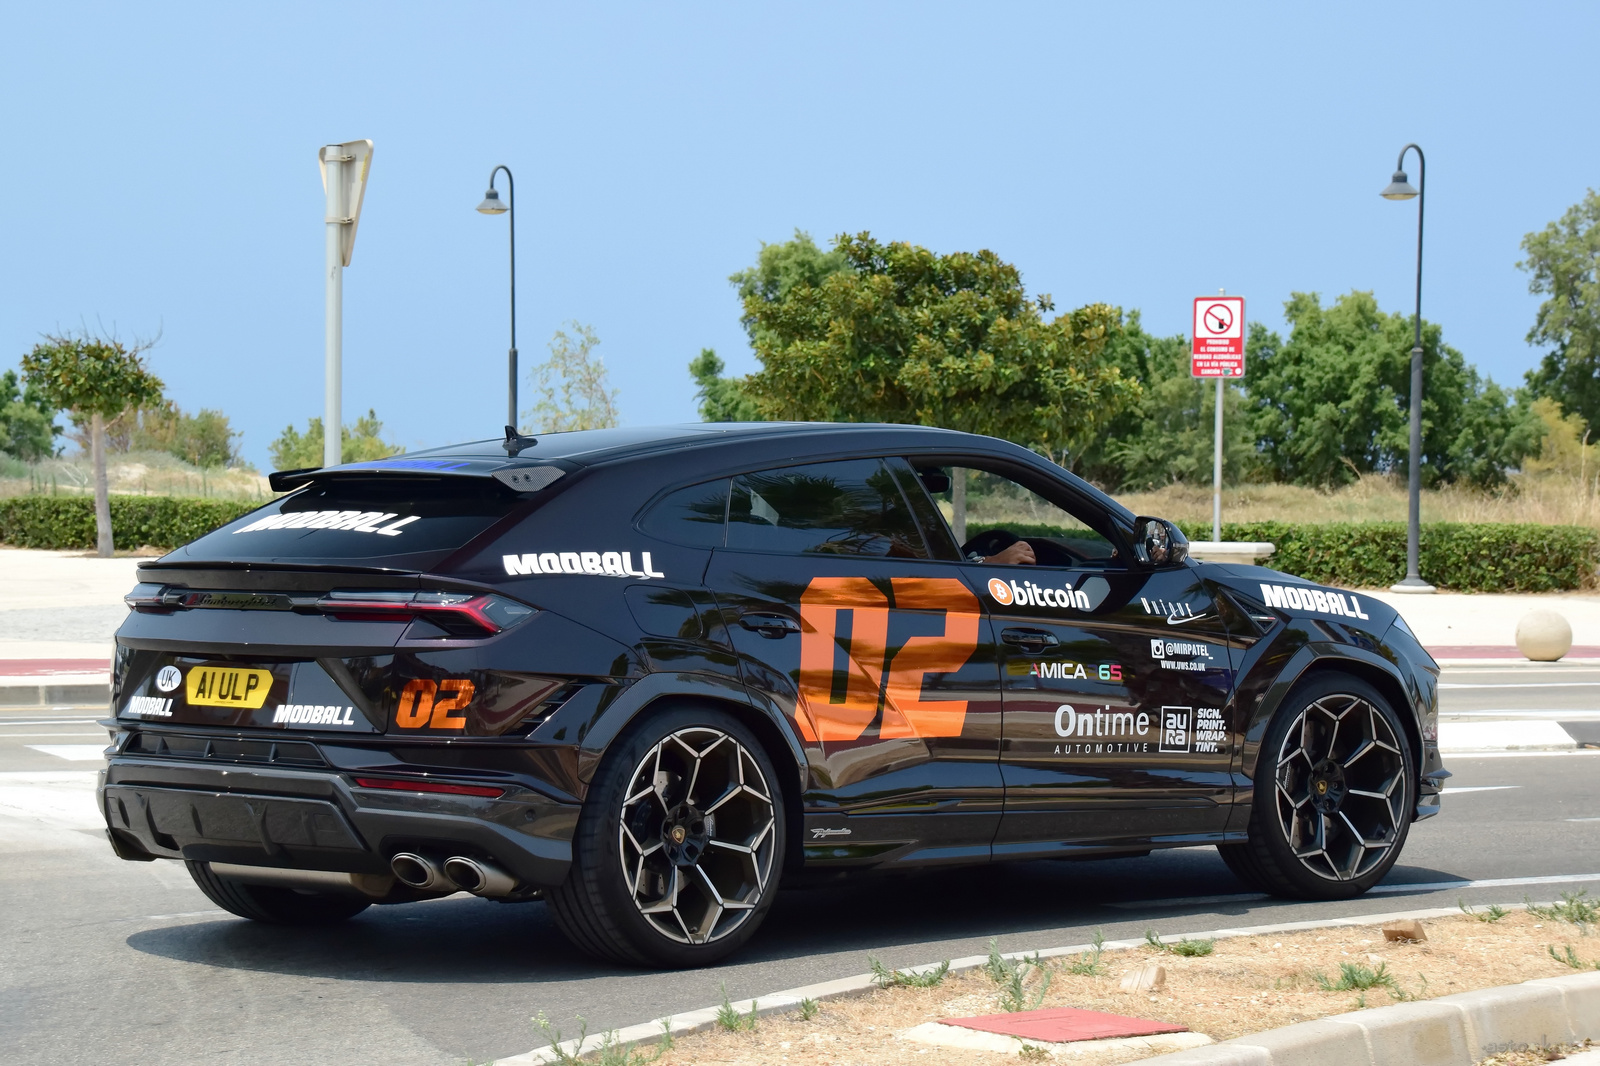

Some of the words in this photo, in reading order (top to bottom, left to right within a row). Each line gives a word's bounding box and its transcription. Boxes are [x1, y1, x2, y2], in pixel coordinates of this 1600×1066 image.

[232, 510, 421, 536] MODBALL
[503, 551, 665, 579] MODBALL
[1010, 579, 1090, 609] bitcoin
[1259, 583, 1369, 620] MODBALL
[794, 576, 980, 742] 02
[161, 670, 177, 688] UK
[218, 672, 259, 701] ULP
[128, 695, 174, 717] MODBALL
[272, 704, 354, 726] MODBALL
[396, 678, 475, 729] 02
[1197, 708, 1222, 719] SIGN.
[1054, 704, 1149, 737] Ontime
[1196, 719, 1227, 730] PRINT.
[1195, 741, 1218, 753] TINT.
[1196, 730, 1227, 741] WRAP.
[1054, 742, 1148, 755] AUTOMOTIVE
